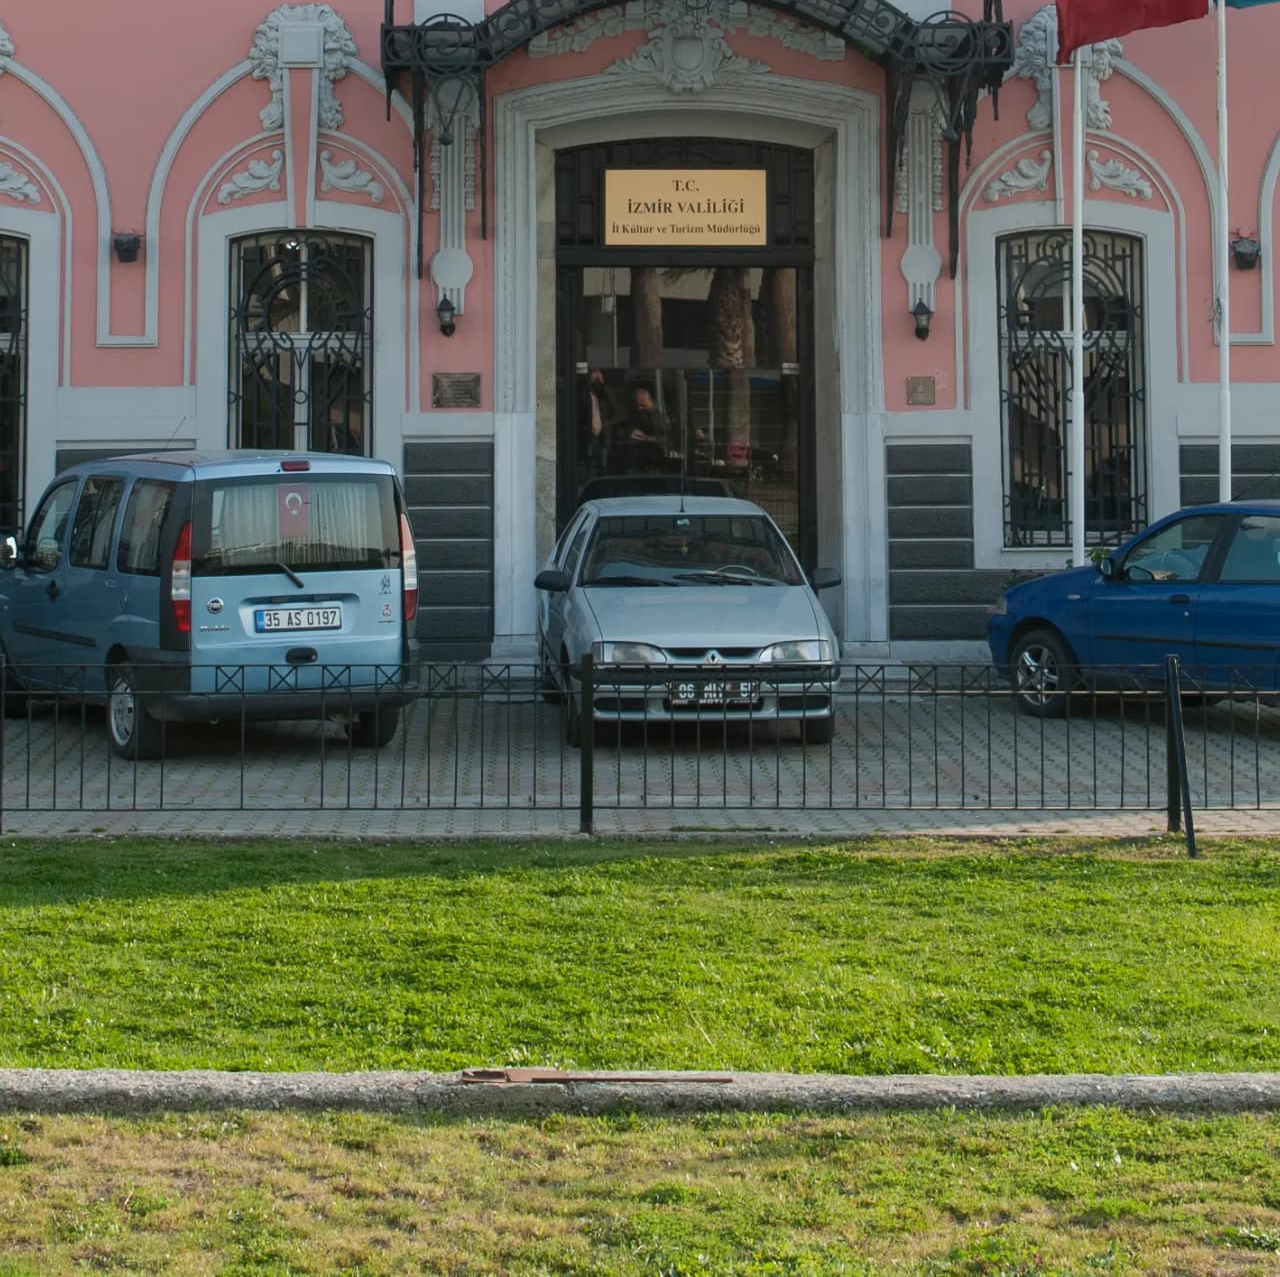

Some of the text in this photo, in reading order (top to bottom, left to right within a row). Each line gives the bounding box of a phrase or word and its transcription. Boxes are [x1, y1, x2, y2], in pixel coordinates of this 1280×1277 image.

[672, 179, 700, 192] T.C.
[627, 198, 745, 214] İZMİR VALİLİĞİ
[656, 226, 668, 234] ve
[670, 223, 704, 234] Turizm
[265, 610, 337, 627] 35 AS 0197
